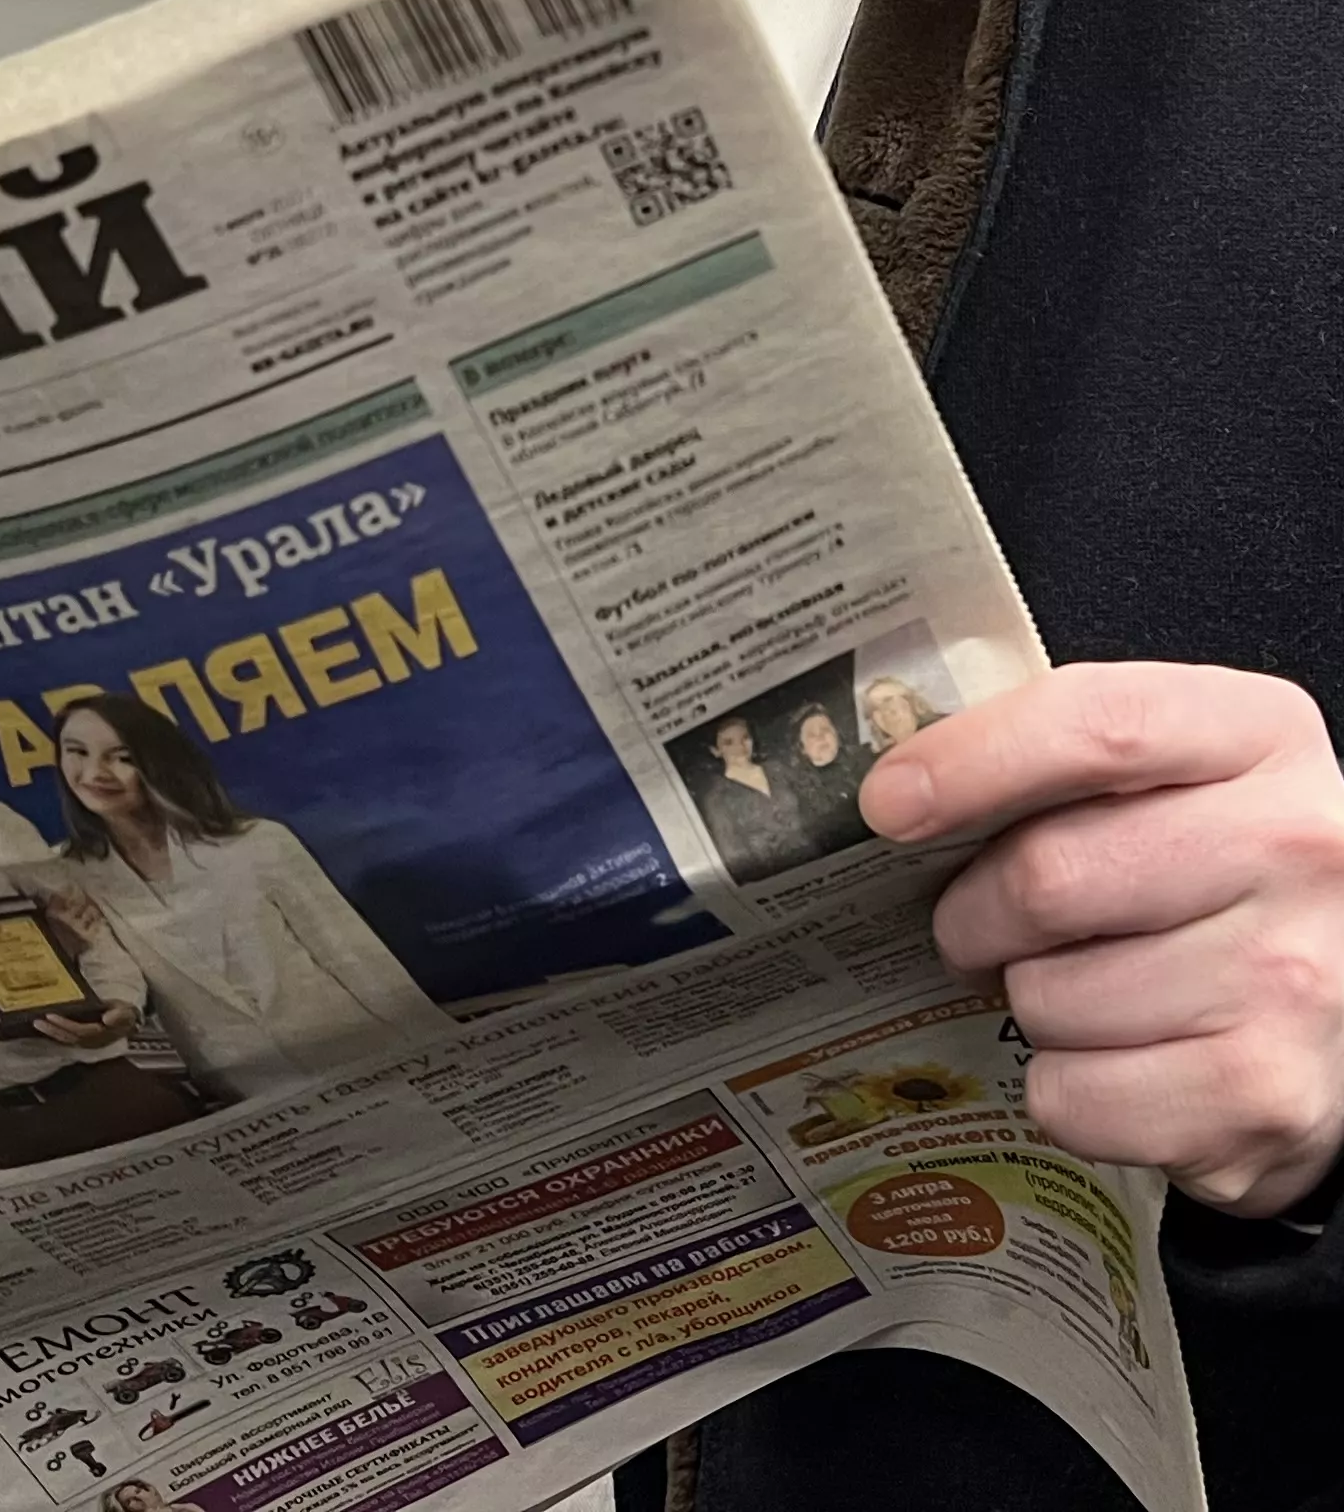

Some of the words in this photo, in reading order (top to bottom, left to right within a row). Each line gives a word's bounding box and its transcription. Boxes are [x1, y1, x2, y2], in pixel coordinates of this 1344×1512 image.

[148, 482, 426, 598] «Урала»
[55, 1150, 176, 1199] можно
[180, 1100, 312, 1162] купить
[315, 1052, 433, 1106] газету
[802, 1108, 1009, 1168] ярмарка-продажа
[883, 1128, 1017, 1160] свежего
[361, 1186, 542, 1259] ТРЕБУЮТСЯ
[543, 1118, 725, 1196] ОХРАННИКИ
[869, 1189, 887, 1205] 3
[889, 1178, 954, 1202] литра
[908, 1150, 999, 1173] Новинка!
[1002, 1151, 1088, 1189] Маточное
[397, 1199, 449, 1224] ООО
[870, 1195, 972, 1223] цветочного
[882, 1228, 938, 1252] 1200
[459, 1266, 649, 1348] Приглашаем
[645, 1253, 685, 1279] на
[683, 1211, 795, 1268] работу:
[478, 1302, 632, 1372] заведующего
[630, 1235, 815, 1311] производством,
[493, 1322, 634, 1390] кондитеров,
[630, 1286, 733, 1335] пекарей,
[507, 1351, 616, 1406] водителя
[615, 1344, 633, 1358] с
[676, 1279, 805, 1339] уборщиков
[226, 1379, 266, 1401] тел.
[262, 1371, 280, 1384] 8
[350, 1346, 431, 1395] Elis
[165, 1453, 239, 1492] Большой
[236, 1410, 323, 1458] размерный
[320, 1397, 355, 1416] ряд
[167, 1436, 239, 1478] Широкий
[236, 1391, 338, 1442] ассортимент
[229, 1428, 340, 1488] НИЖНЕЕ
[345, 1425, 451, 1478] СЕРТИФИКАТЫ
